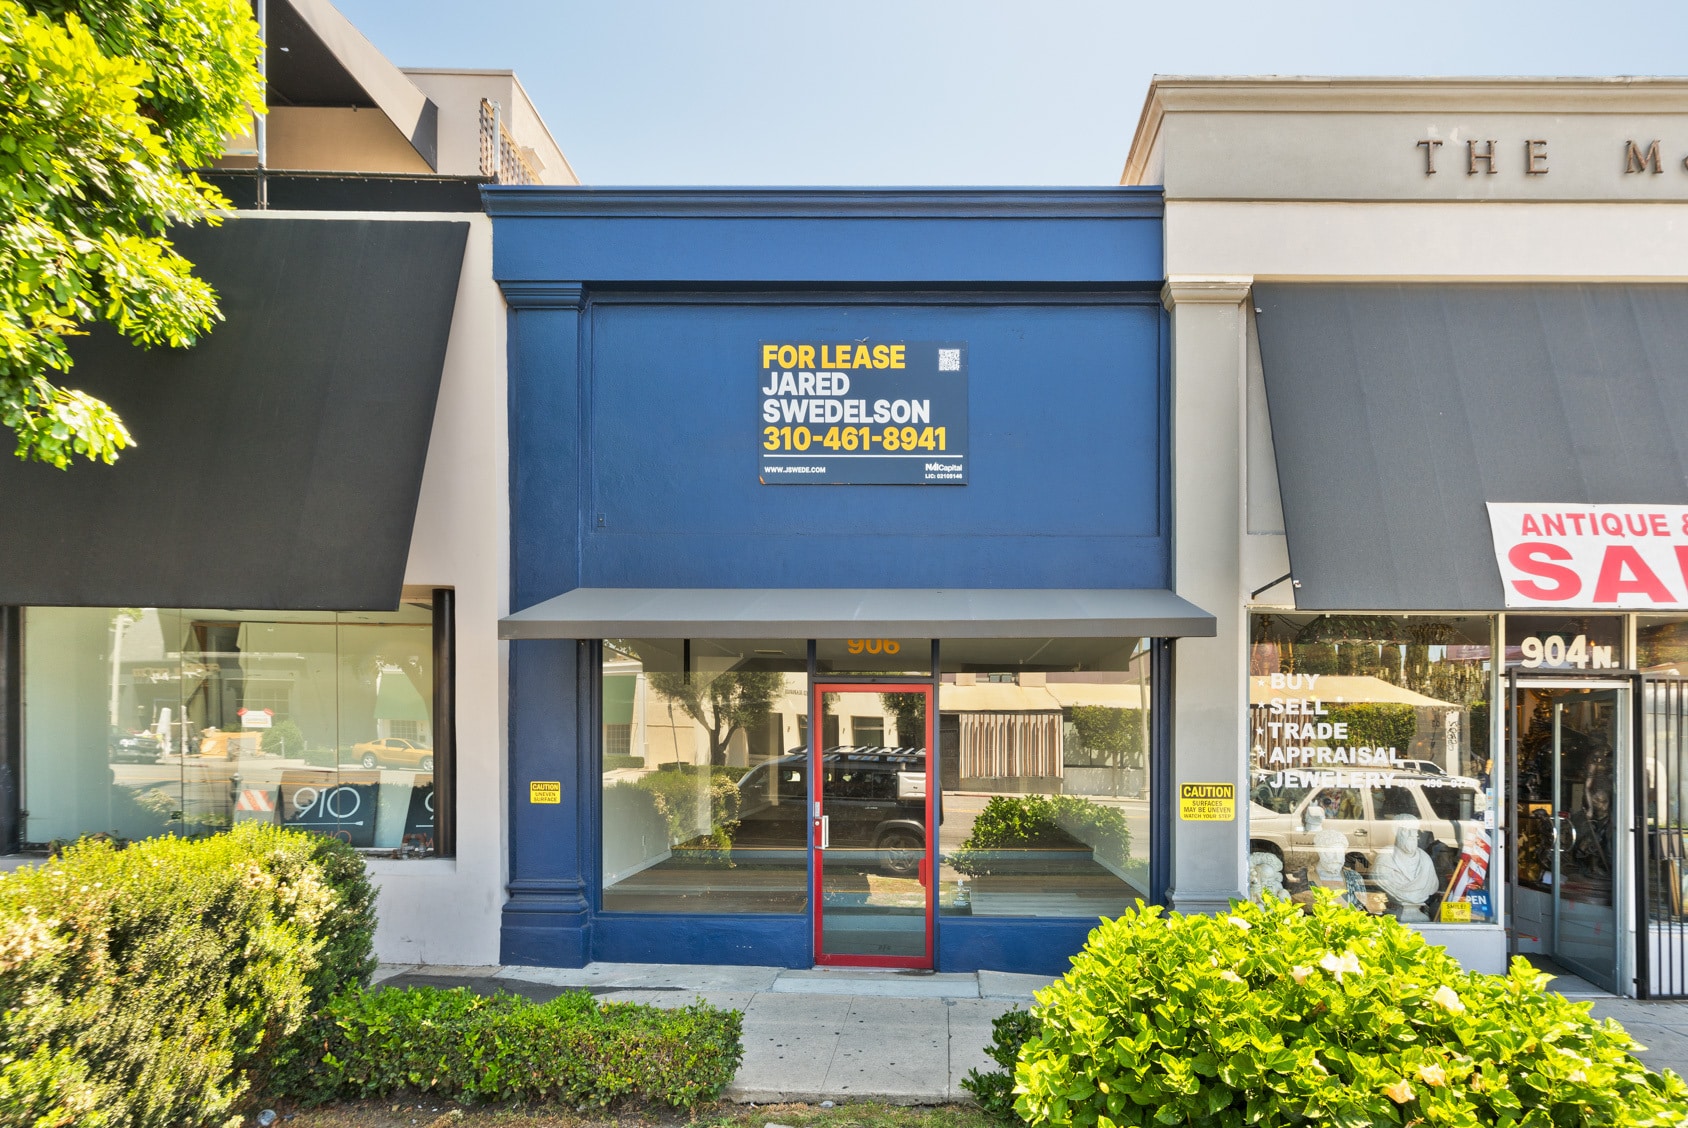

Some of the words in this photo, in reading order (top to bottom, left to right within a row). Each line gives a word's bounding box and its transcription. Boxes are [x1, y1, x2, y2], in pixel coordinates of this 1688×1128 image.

[1416, 139, 1550, 175] THE
[1623, 139, 1688, 175] M
[763, 345, 816, 369] FOR
[821, 345, 906, 369] LEASE
[763, 372, 850, 396] JARED
[763, 399, 930, 423] SWEDELSON
[763, 426, 946, 451] 310-461-8941
[1521, 513, 1671, 538] ANTIQUE
[1508, 542, 1688, 604] SA
[847, 638, 900, 655] 906
[1521, 635, 1589, 669] 904
[1270, 673, 1320, 690] BUY
[1270, 698, 1328, 715] SELL
[1267, 722, 1348, 740] TRADE
[1269, 747, 1404, 764] APPRAISAL
[1183, 786, 1231, 798] CAUTION
[1270, 772, 1395, 789] JEWELERY
[293, 787, 361, 818] 910
